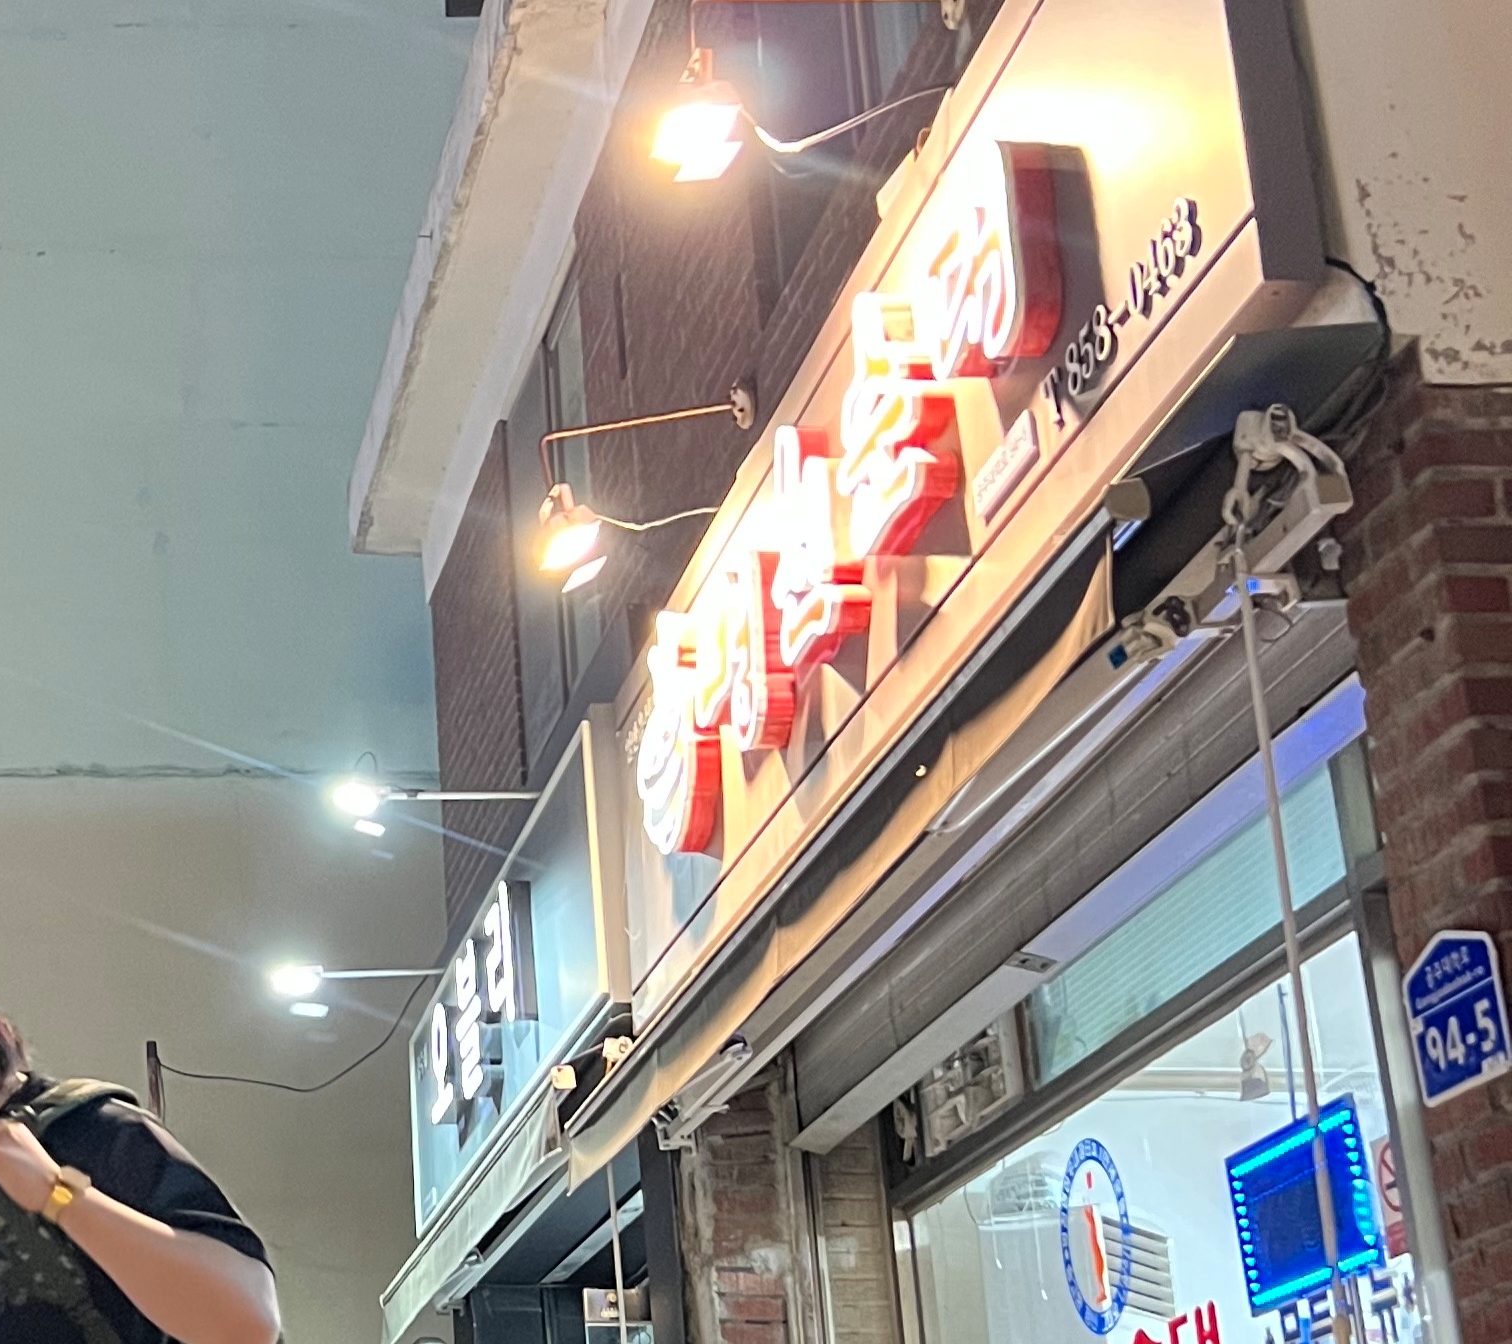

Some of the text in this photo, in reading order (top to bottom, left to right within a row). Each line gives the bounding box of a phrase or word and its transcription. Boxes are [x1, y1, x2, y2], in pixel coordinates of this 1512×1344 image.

[1040, 196, 1201, 433] T 858-0463
[1424, 997, 1497, 1071] 94-5
